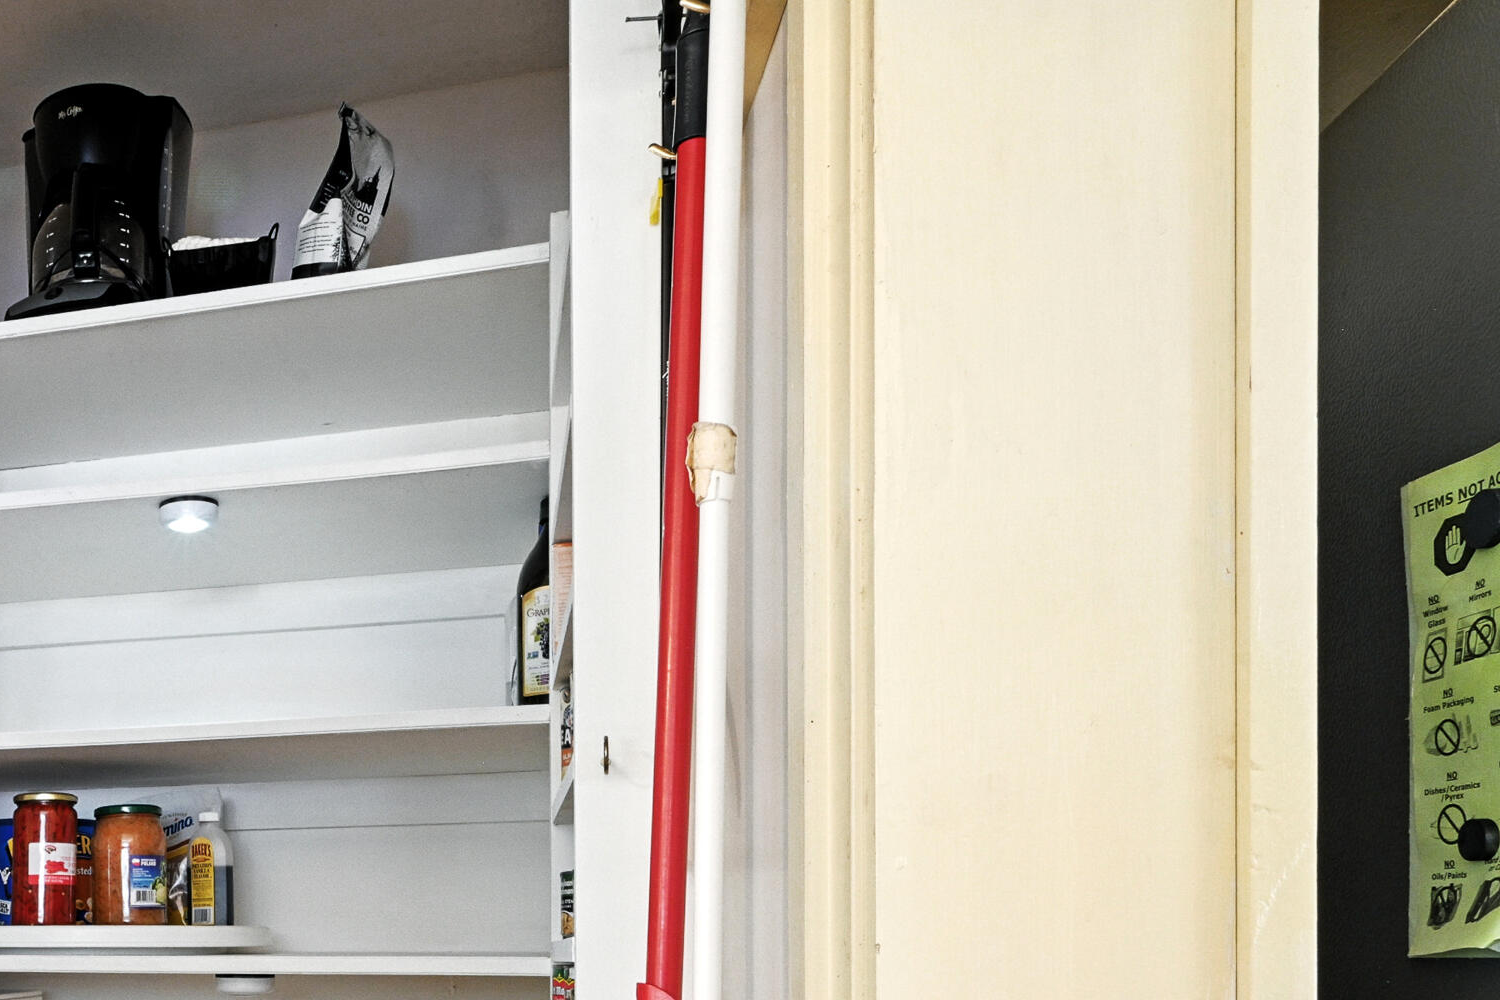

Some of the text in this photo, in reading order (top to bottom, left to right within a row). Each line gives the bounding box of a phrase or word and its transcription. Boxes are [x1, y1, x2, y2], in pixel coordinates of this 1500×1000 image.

[1413, 491, 1454, 518] ITEMS
[1458, 479, 1485, 501] NOT
[1475, 578, 1486, 590] NO
[1428, 594, 1440, 605] NO
[1468, 590, 1492, 603] Mirrors
[1422, 605, 1449, 618] Window
[1428, 617, 1446, 629] Glass
[1443, 688, 1454, 698] NO
[1423, 696, 1475, 714] Foam Packaging
[1446, 771, 1458, 781] NO
[1424, 781, 1481, 797] Dishes/Ceramics
[1441, 792, 1464, 803] /Pyrex
[163, 815, 193, 837] mino
[191, 843, 212, 858] BAKER'S
[1444, 859, 1456, 869] NO
[1431, 871, 1467, 881] Oils/Paints
